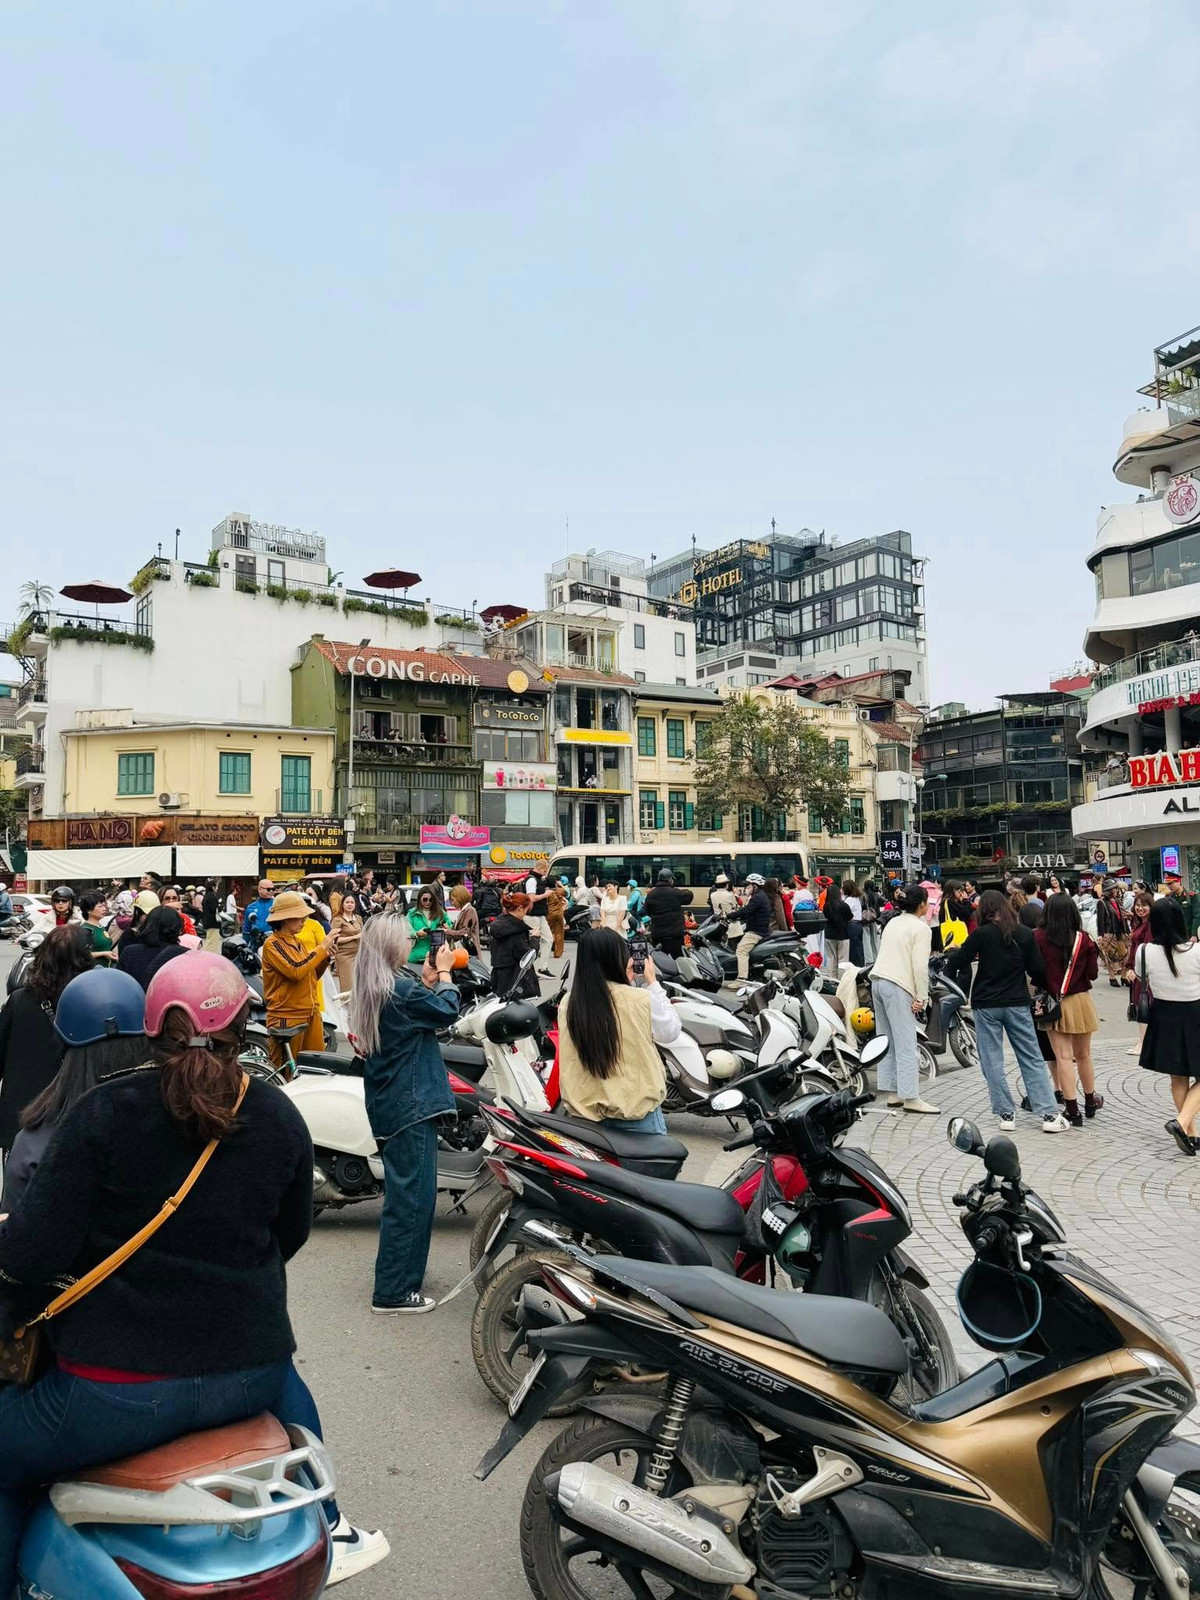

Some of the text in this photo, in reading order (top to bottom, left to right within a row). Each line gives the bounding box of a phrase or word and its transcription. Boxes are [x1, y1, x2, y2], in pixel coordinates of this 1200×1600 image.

[702, 568, 743, 596] HOTEL
[1126, 674, 1170, 705] HANOI
[1129, 754, 1179, 788] BIA
[883, 851, 901, 860] SPA
[885, 840, 898, 849] FS
[1017, 854, 1068, 868] KAFA
[552, 1179, 608, 1204] VISION
[679, 1341, 790, 1393] AIR BLADE
